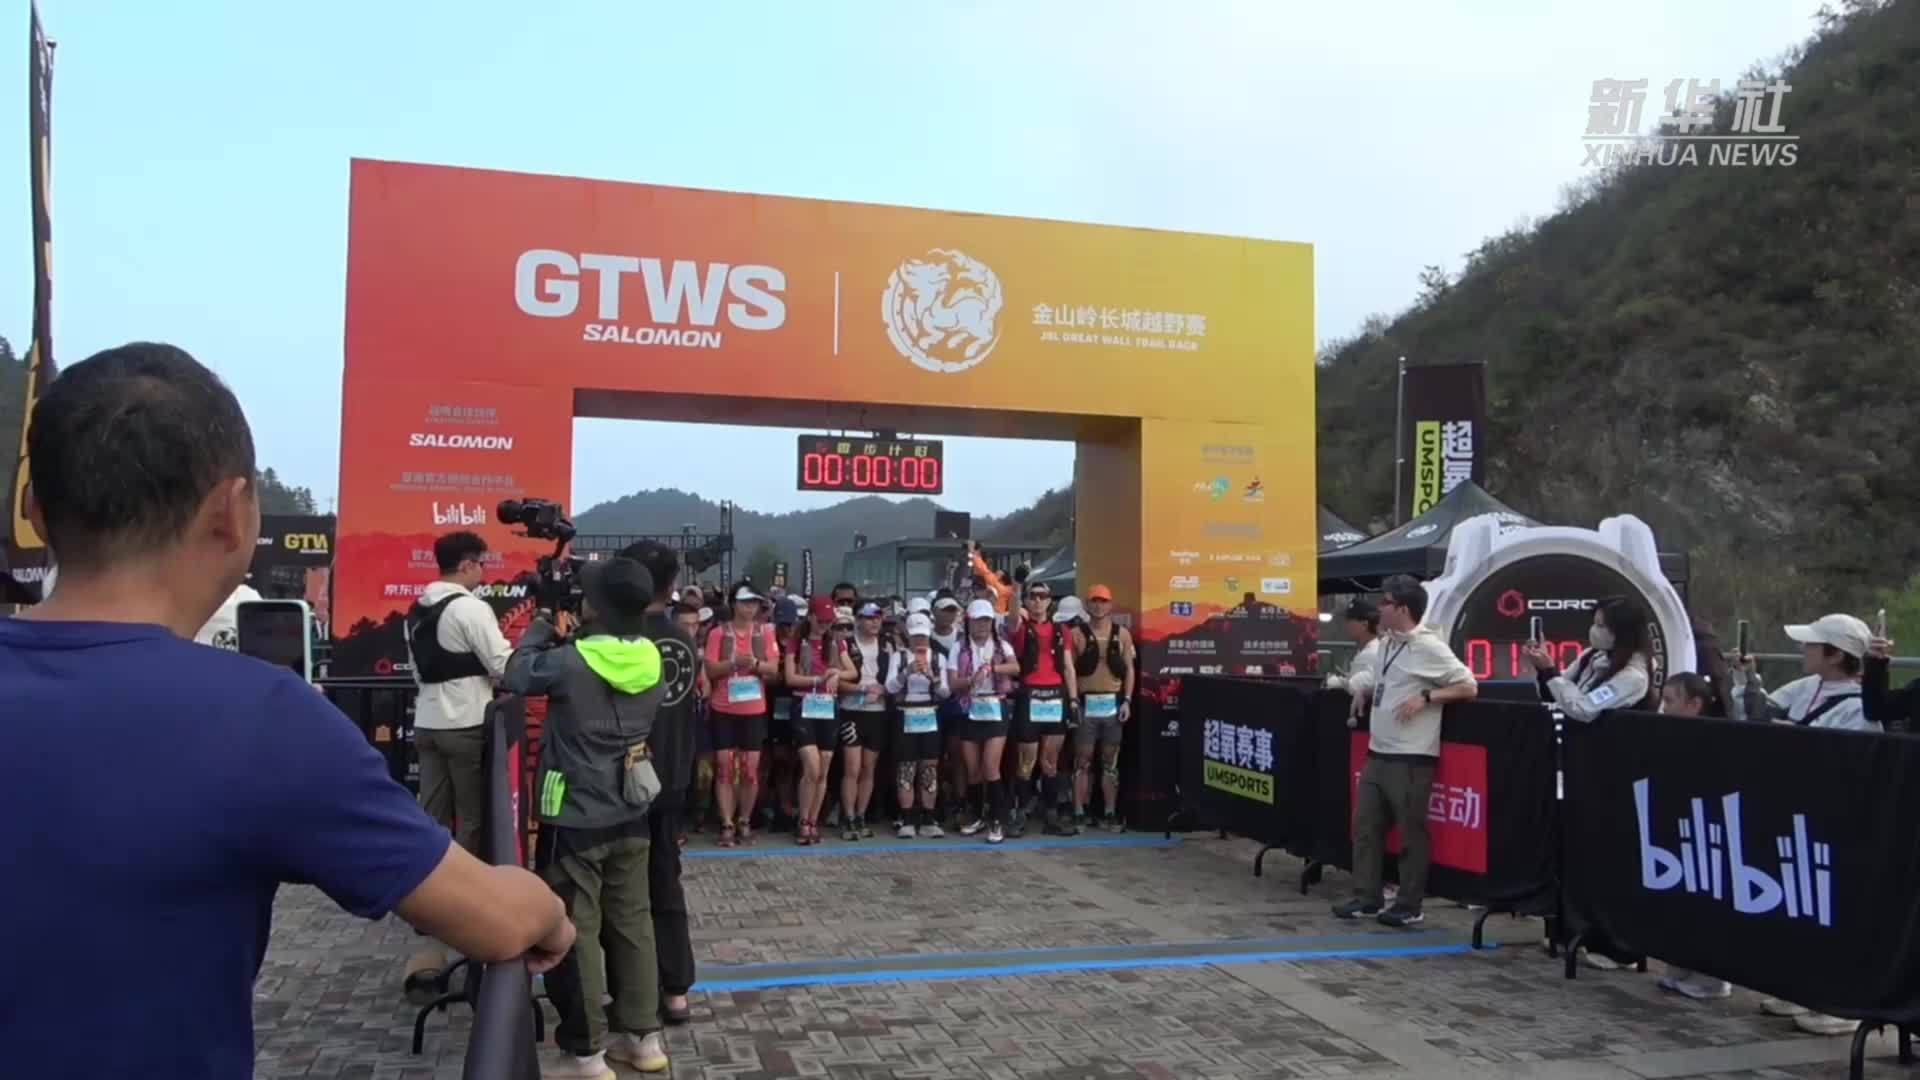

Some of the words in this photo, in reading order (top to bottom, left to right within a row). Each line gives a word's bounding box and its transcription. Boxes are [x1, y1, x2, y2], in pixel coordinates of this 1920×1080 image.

[514, 248, 787, 331] GTWS
[583, 322, 722, 349] SALOMON
[1031, 302, 1207, 337] 金山岭长城越野赛
[1062, 333, 1099, 344] GREAT
[1102, 335, 1131, 346] WALL
[408, 432, 513, 450] SALOMON
[804, 453, 938, 489] 00:00:00
[1418, 430, 1435, 514] UMSPO
[432, 501, 487, 525] bilibili
[284, 533, 329, 549] GTW
[1206, 765, 1270, 796] UMSPORTS
[1427, 782, 1481, 829] 运动
[1632, 777, 1831, 927] bilibili
